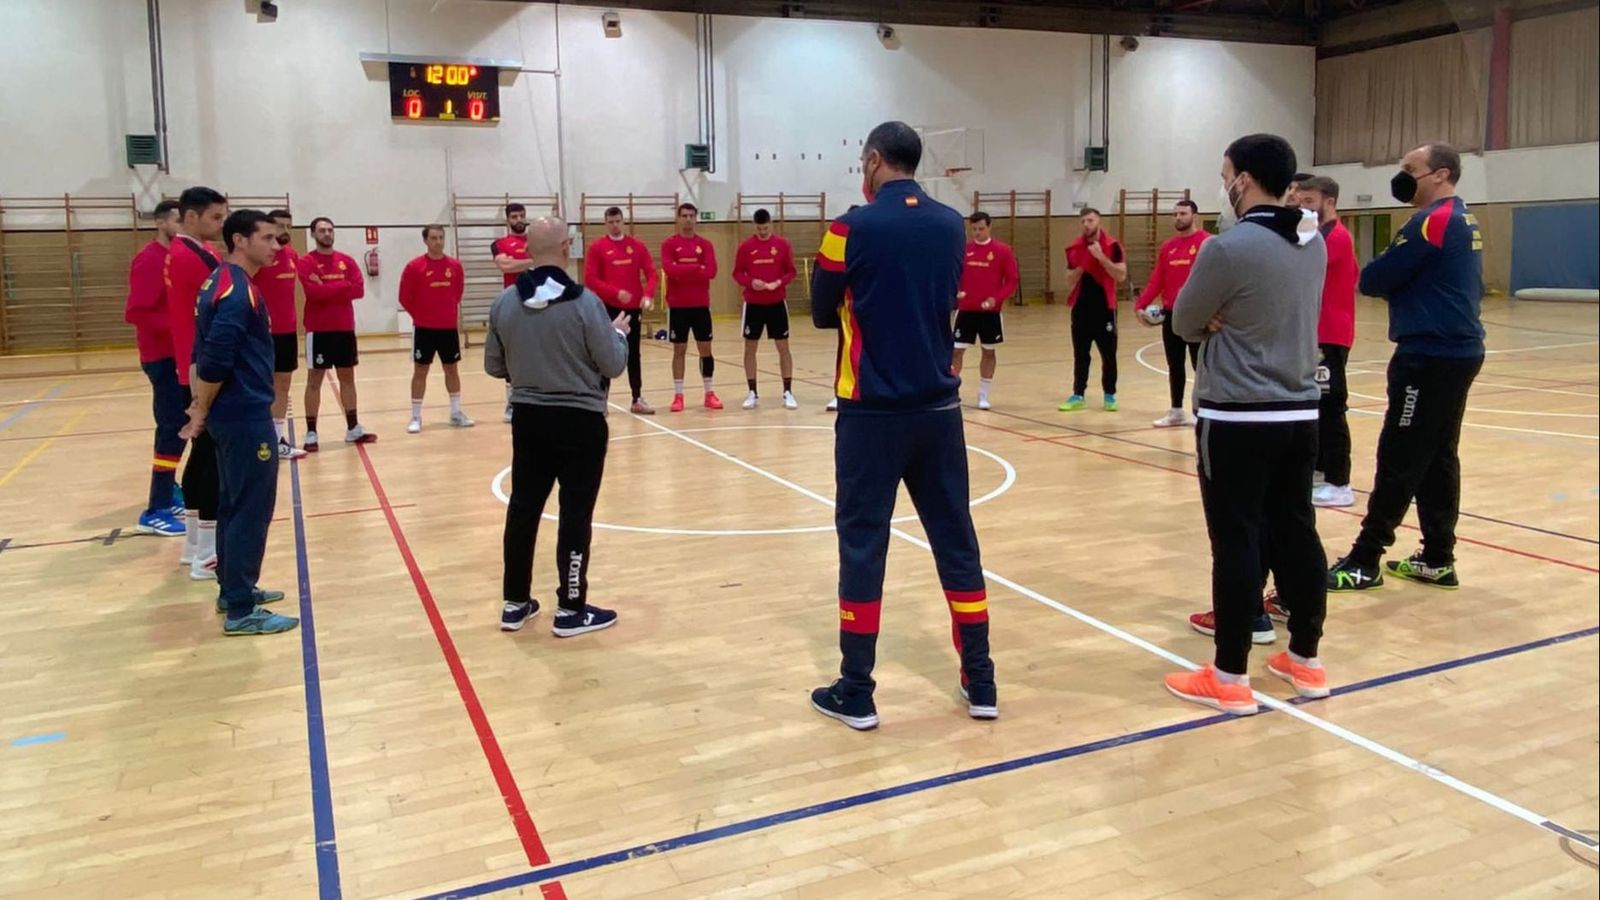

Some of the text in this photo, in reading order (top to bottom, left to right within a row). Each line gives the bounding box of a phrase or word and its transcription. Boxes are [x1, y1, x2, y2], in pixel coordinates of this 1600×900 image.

[409, 99, 421, 119] 0
[471, 101, 484, 120] 0
[1398, 385, 1420, 427] Joma
[567, 550, 583, 600] Joma
